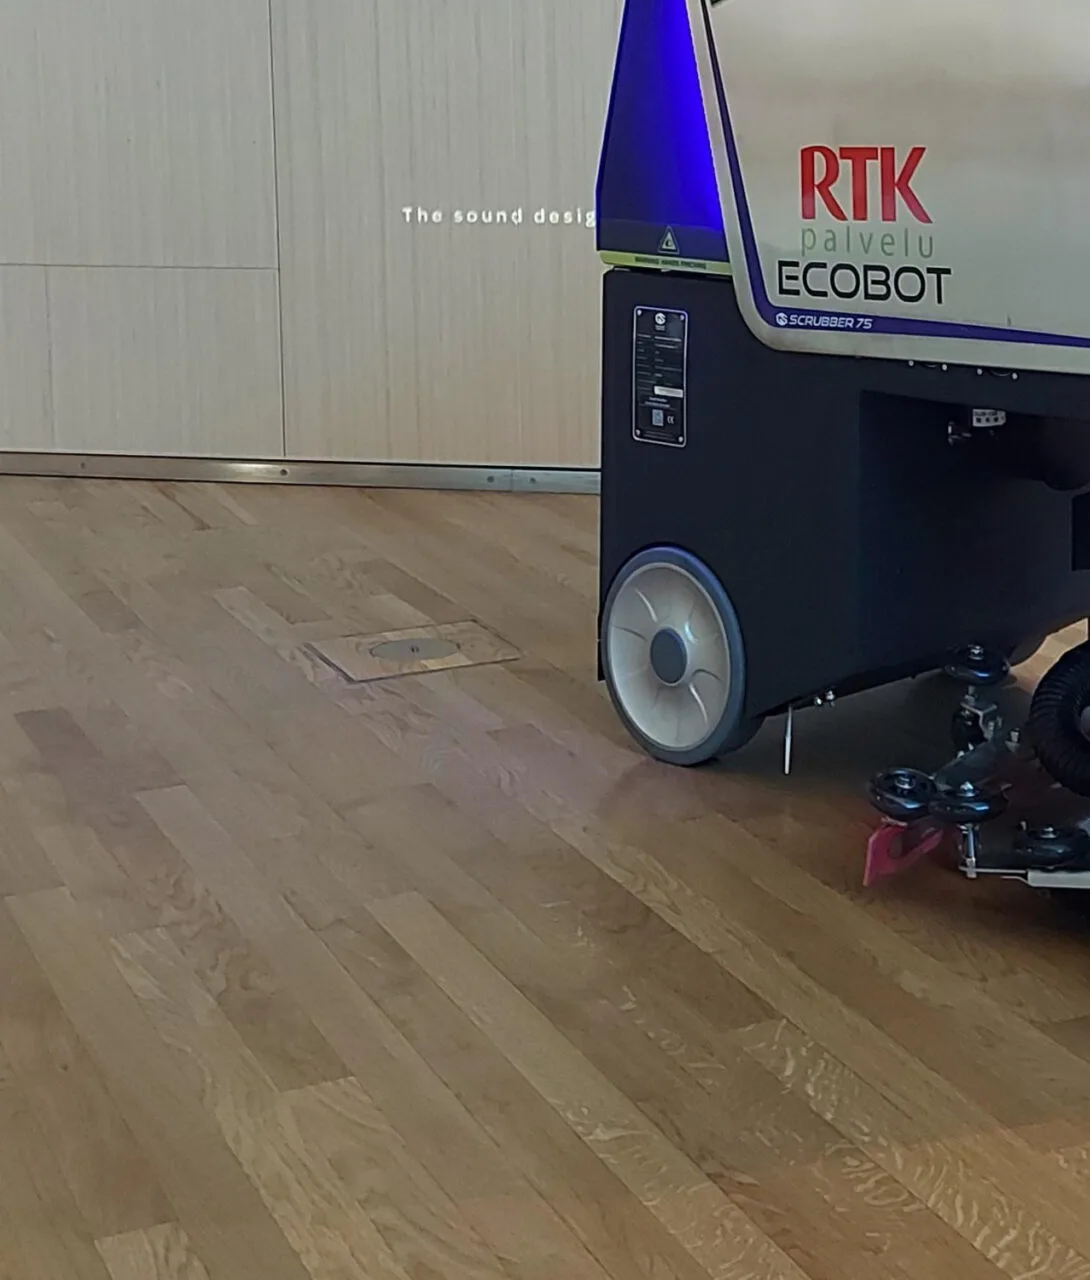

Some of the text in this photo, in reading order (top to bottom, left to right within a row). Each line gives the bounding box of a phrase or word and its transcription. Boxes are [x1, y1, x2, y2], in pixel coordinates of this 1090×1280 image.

[800, 145, 933, 224] RTK
[402, 206, 596, 228] The sound desig
[801, 225, 933, 259] palvelu
[777, 259, 952, 305] ECOBOT
[789, 314, 873, 330] SCRUBBER 75
